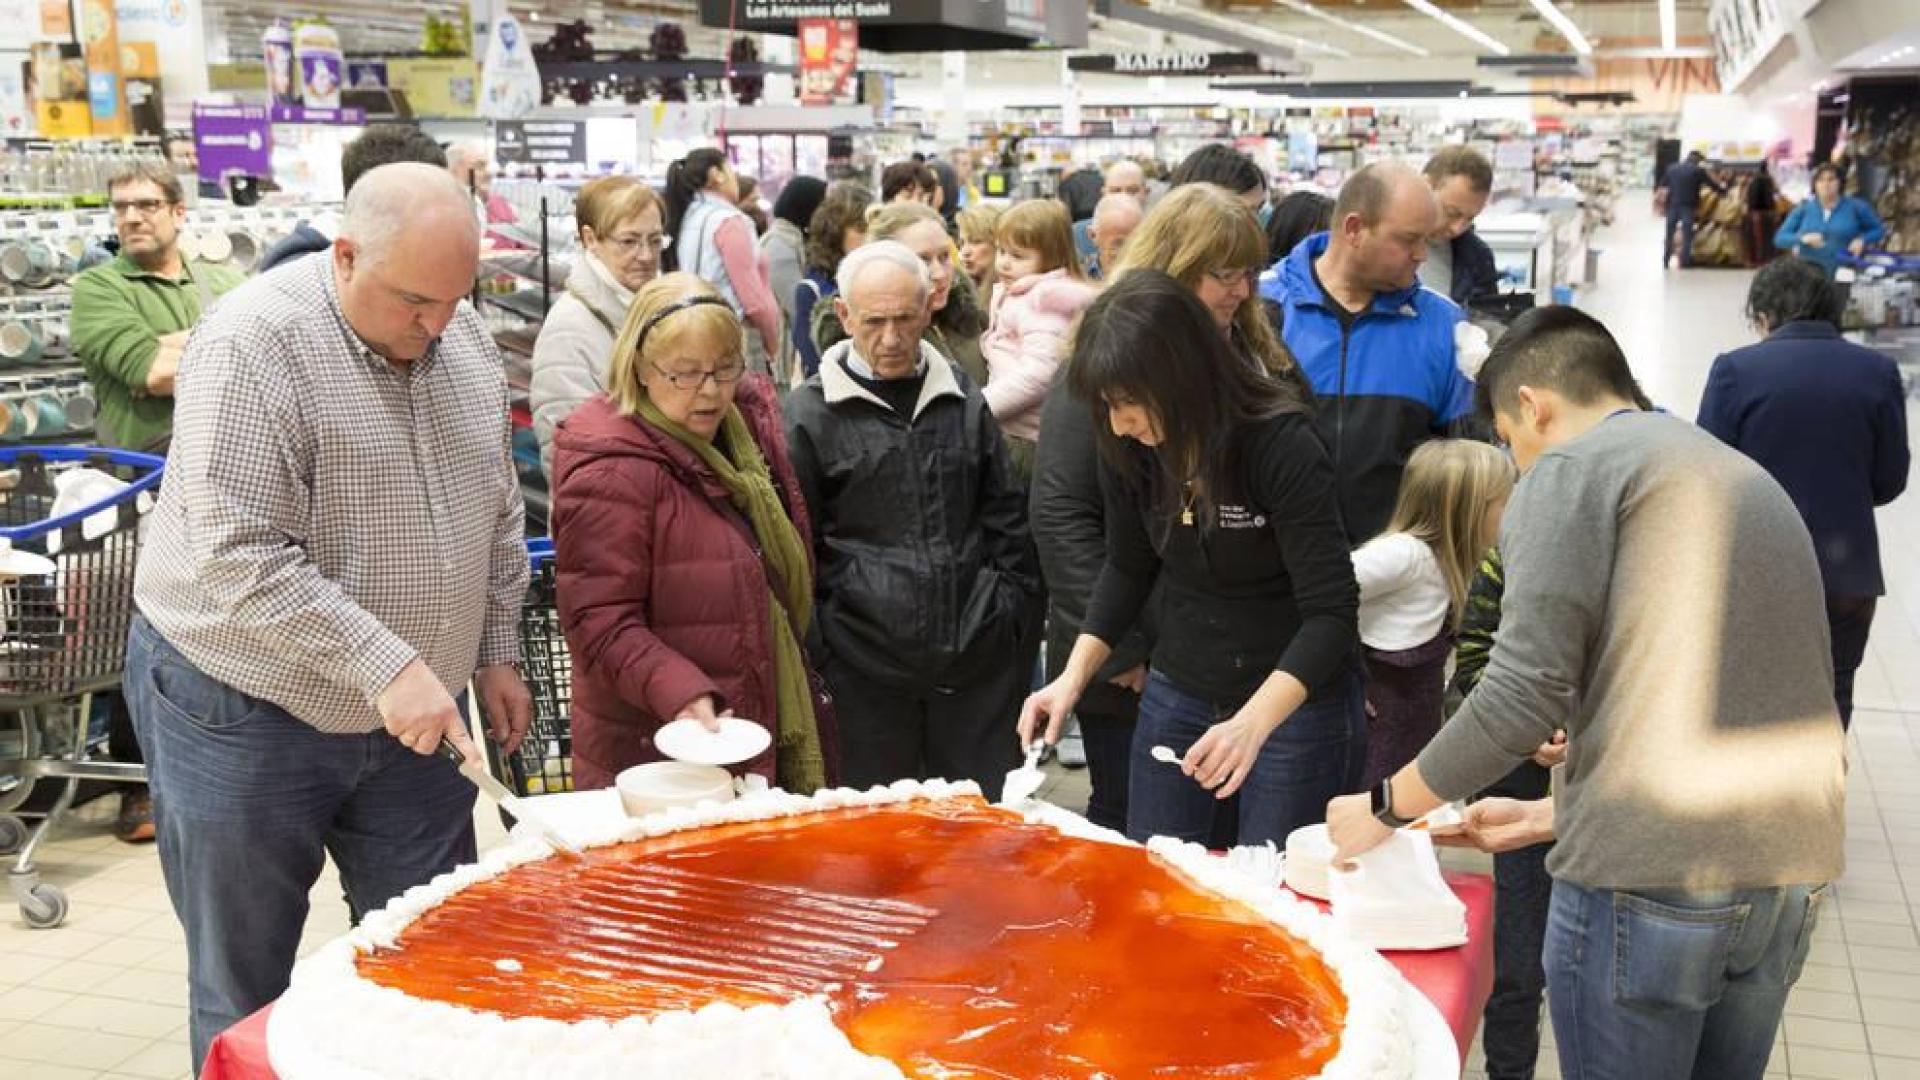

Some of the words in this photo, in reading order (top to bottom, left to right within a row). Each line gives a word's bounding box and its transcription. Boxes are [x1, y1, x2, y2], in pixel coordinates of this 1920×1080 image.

[746, 4, 769, 18] Los
[771, 4, 831, 17] Artesanos
[833, 3, 853, 16] del
[855, 2, 891, 16] Sushi
[1646, 57, 1721, 93] VIN
